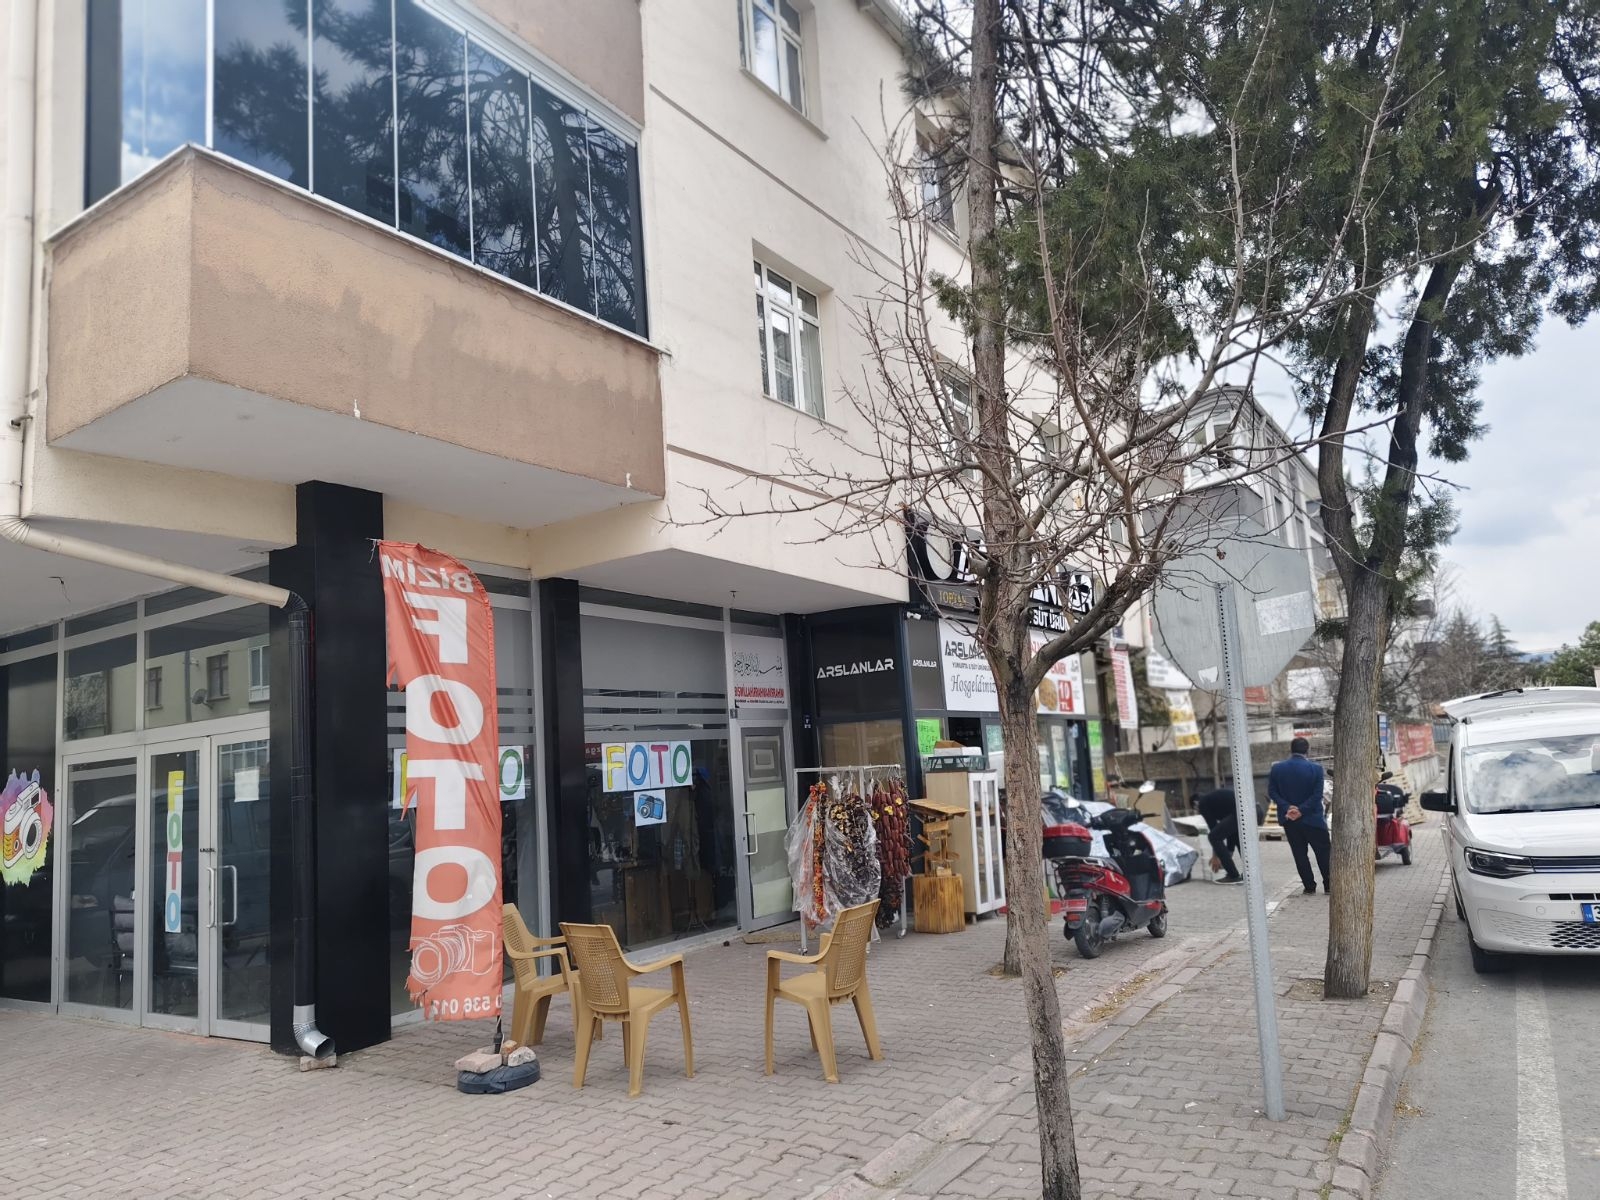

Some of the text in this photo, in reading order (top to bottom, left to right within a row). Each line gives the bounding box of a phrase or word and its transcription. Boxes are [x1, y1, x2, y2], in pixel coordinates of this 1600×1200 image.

[1032, 606, 1049, 627] SÜT
[817, 658, 895, 679] ARSLANLAR
[951, 674, 996, 698] Hoşgeldiniz
[1059, 681, 1071, 700] 10
[1060, 702, 1070, 711] TL
[606, 743, 691, 790] FOTO
[165, 771, 184, 932] FOTO
